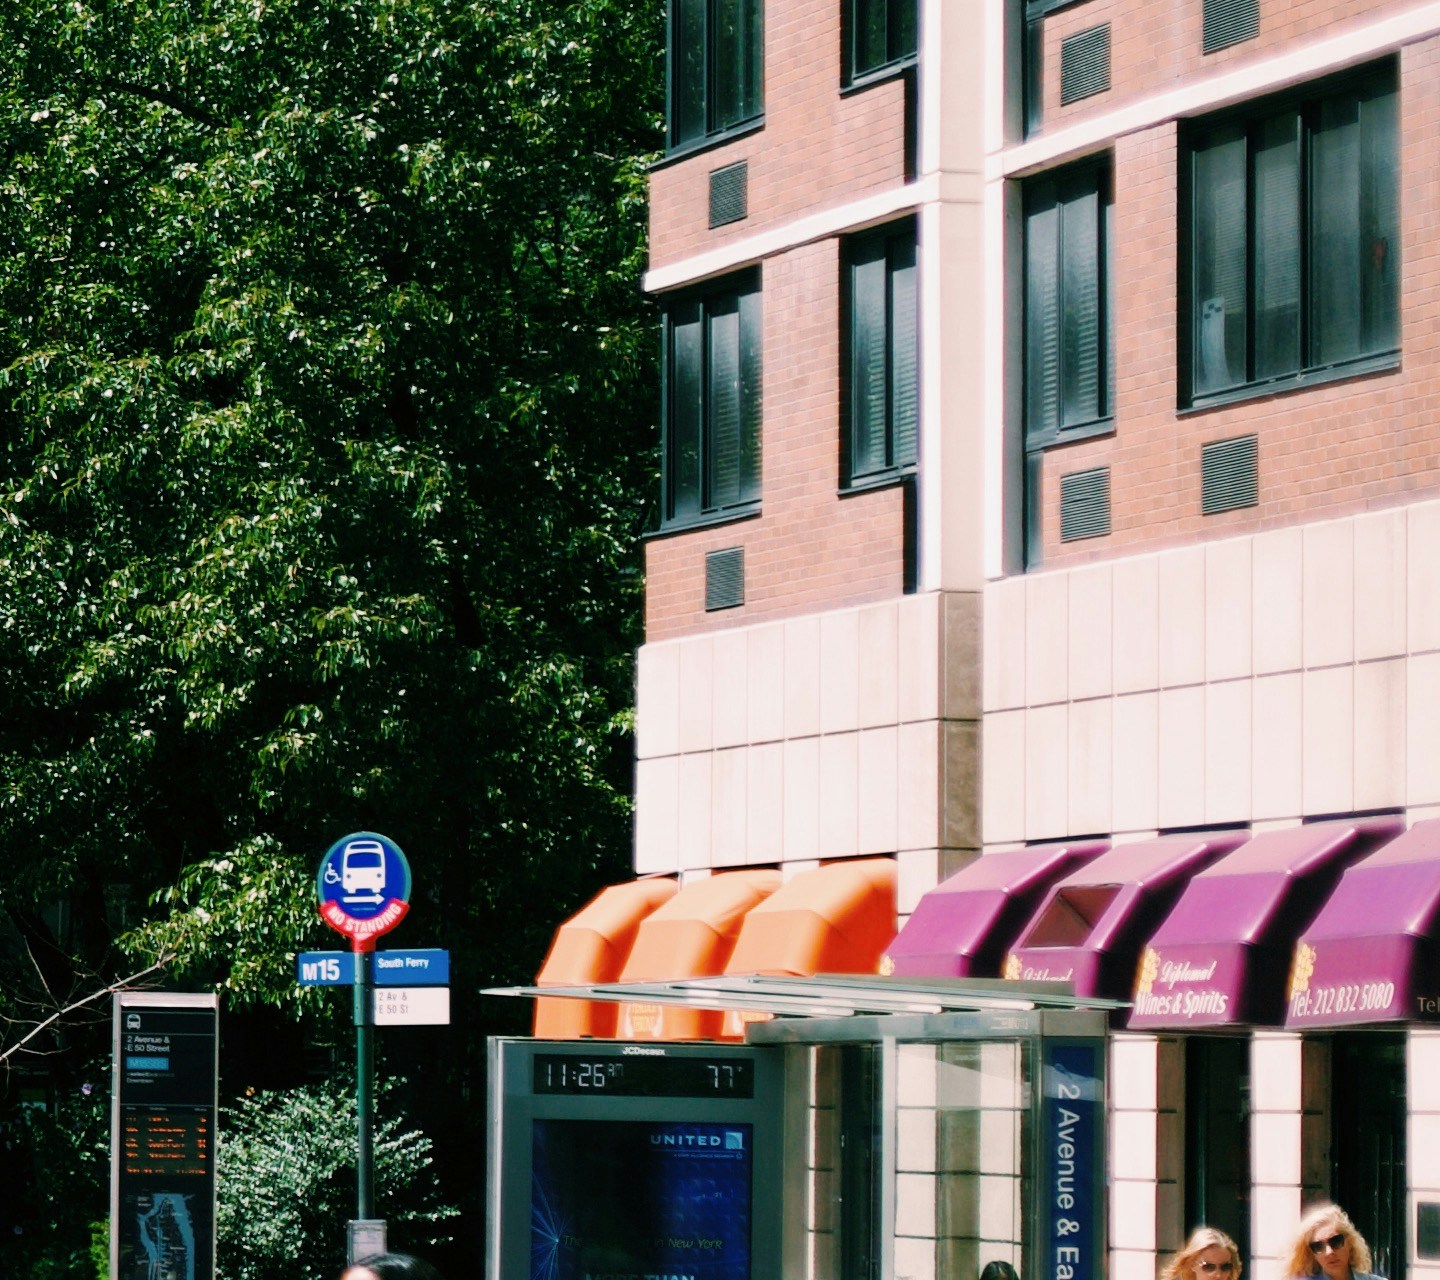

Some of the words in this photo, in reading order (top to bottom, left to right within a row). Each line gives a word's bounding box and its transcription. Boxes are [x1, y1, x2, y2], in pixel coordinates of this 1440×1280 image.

[329, 905, 345, 926] NO
[345, 902, 402, 934] STANDING
[302, 958, 340, 981] M15
[377, 957, 404, 969] South
[405, 957, 429, 970] Ferry
[378, 992, 384, 1002] 2
[386, 992, 397, 1002] Av
[401, 992, 408, 1002] &
[1135, 992, 1171, 1016] Wines
[1171, 992, 1182, 1015] &
[1182, 989, 1228, 1018] Spirits
[1291, 991, 1313, 1017] Tel:
[1312, 988, 1335, 1015] 212
[1335, 985, 1359, 1012] 832
[1359, 982, 1395, 1010] 5080
[378, 1005, 384, 1014] E
[386, 1005, 397, 1014] 50
[400, 1005, 409, 1014] St
[126, 1036, 133, 1044] 2
[133, 1036, 163, 1044] Avenue
[163, 1036, 170, 1044] &
[134, 1044, 145, 1053] 50
[145, 1044, 170, 1053] Street
[546, 1063, 605, 1088] 11:26
[1058, 1084, 1080, 1101] 2
[650, 1134, 721, 1147] UNITED
[1056, 1107, 1080, 1210] Avenue
[1056, 1218, 1080, 1237] &
[668, 1238, 693, 1249] New
[697, 1238, 722, 1250] York
